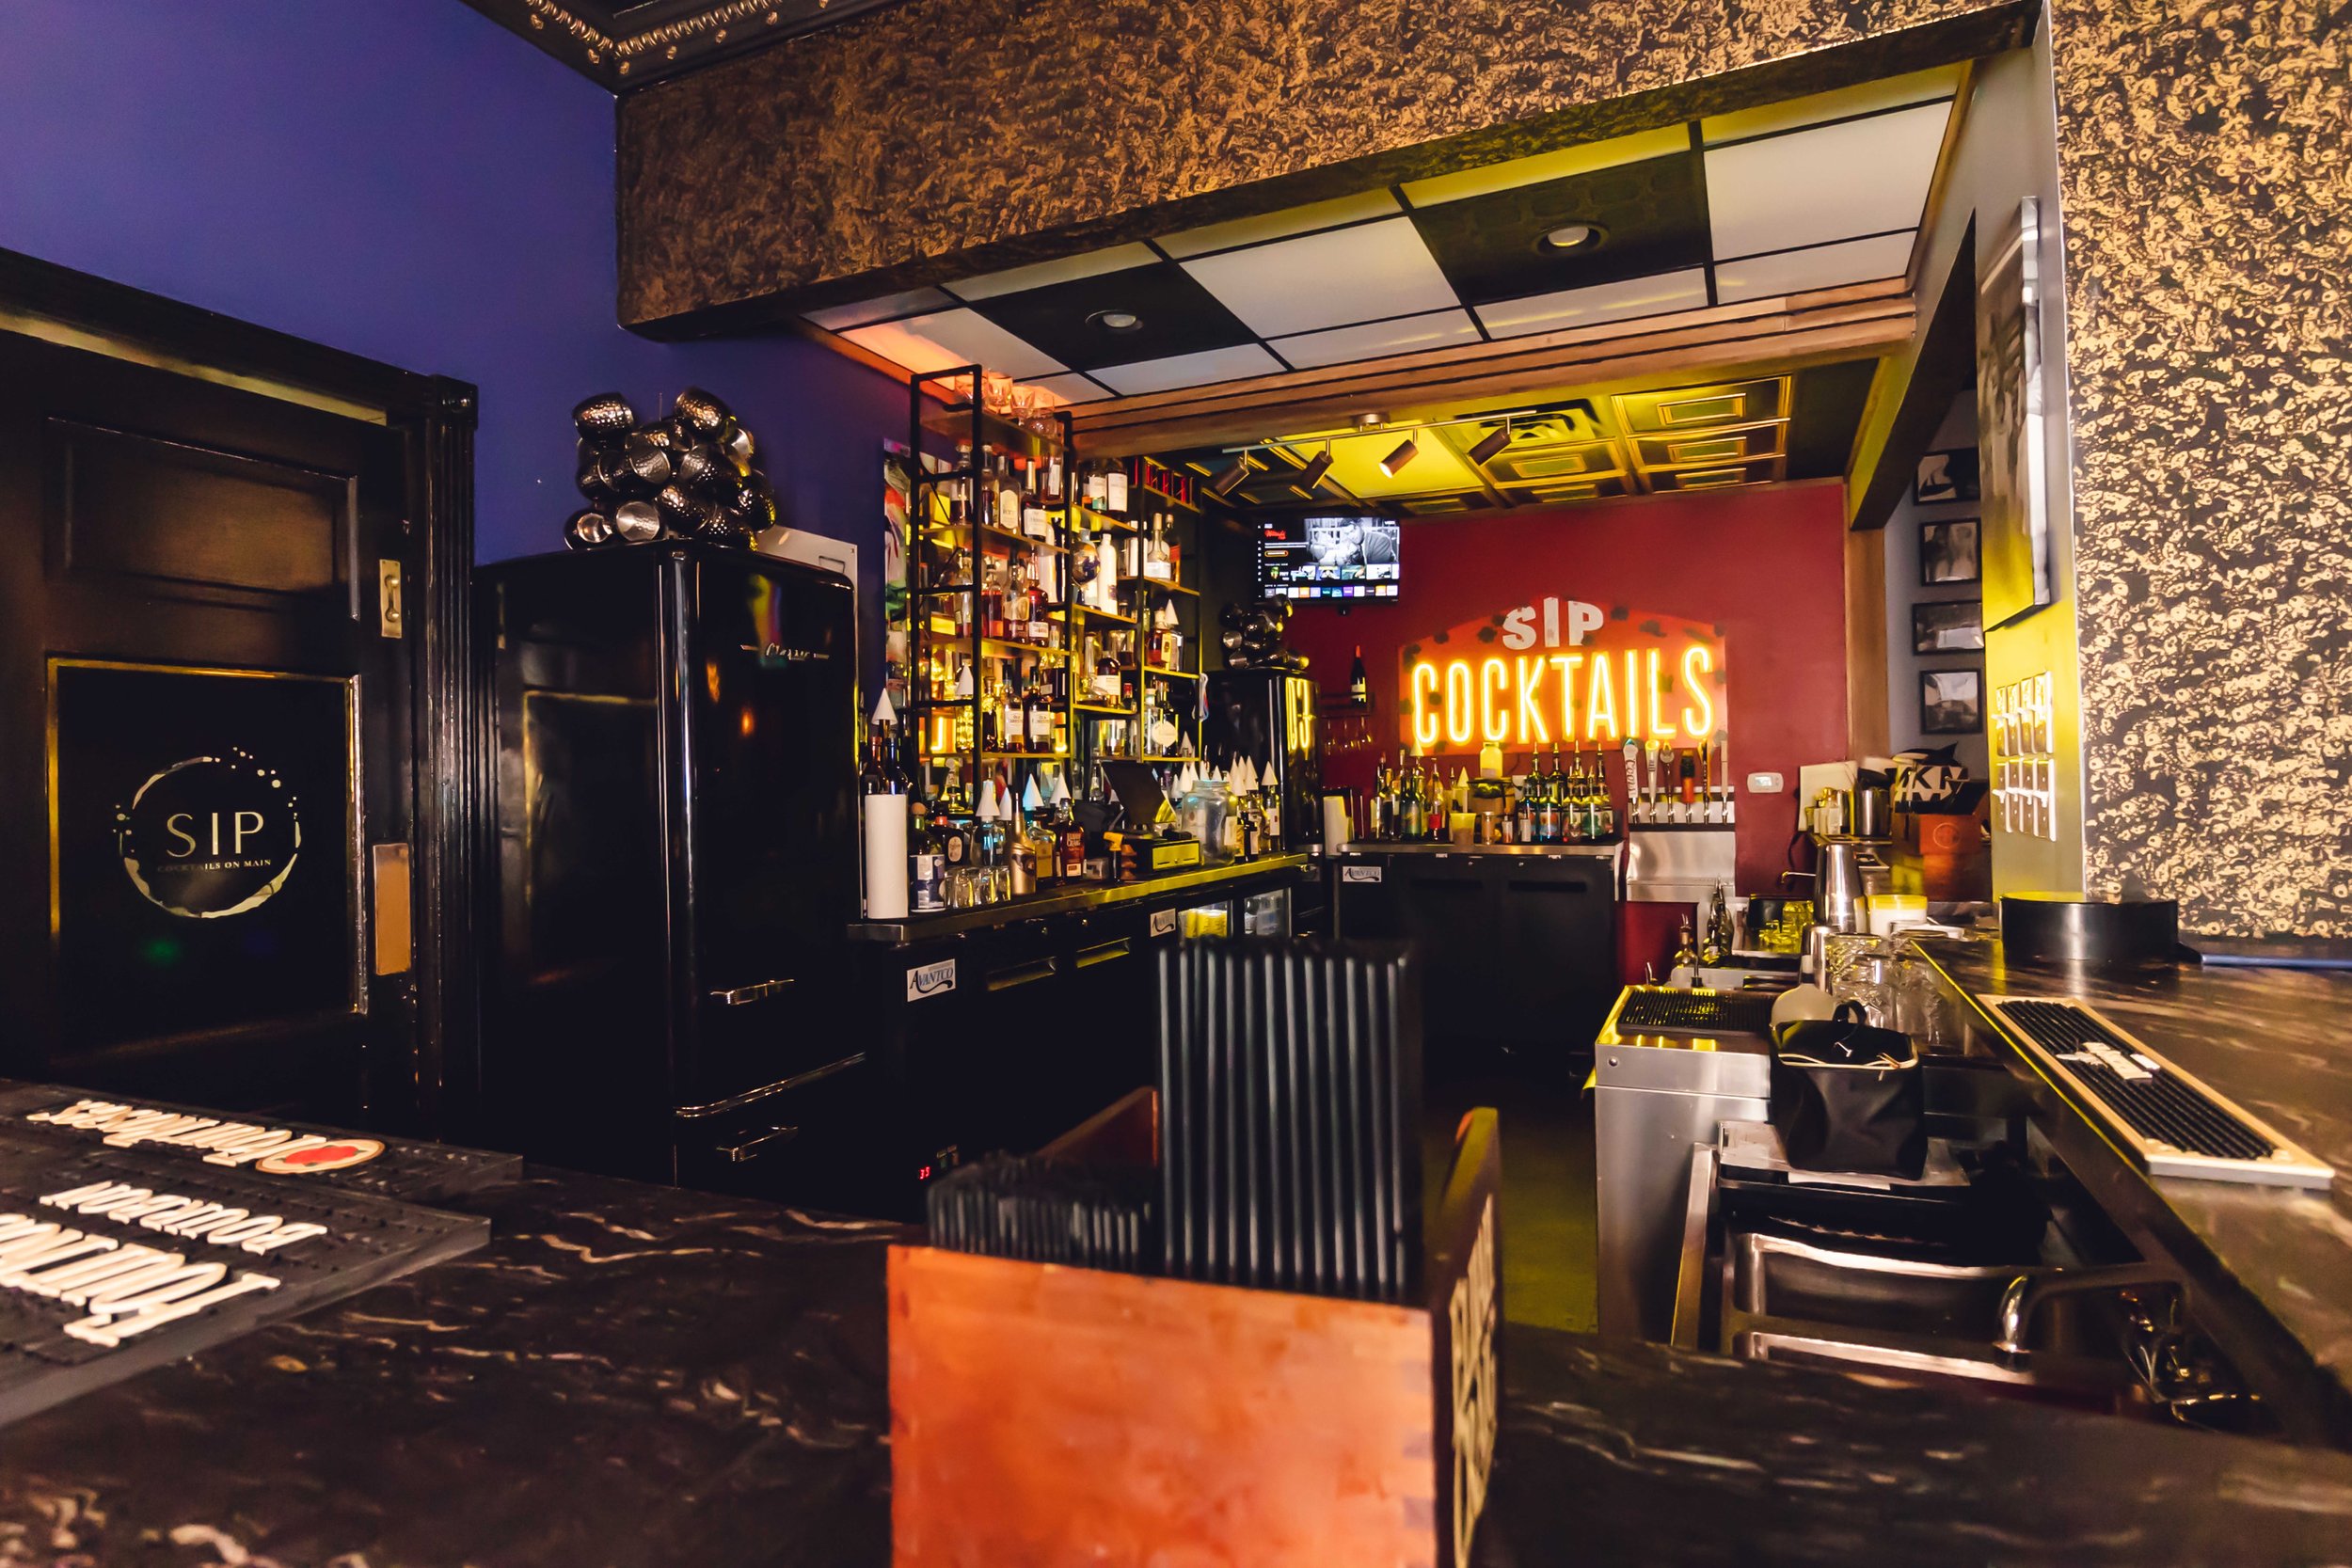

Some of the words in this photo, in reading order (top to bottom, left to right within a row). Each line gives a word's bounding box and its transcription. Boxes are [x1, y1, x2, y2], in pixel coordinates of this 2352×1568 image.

[1502, 596, 1604, 651] SIP
[1412, 643, 1713, 745] COCKTAILS
[167, 811, 264, 858] SIP
[225, 861, 240, 869] ON
[244, 859, 272, 867] MAIN
[40, 1180, 327, 1256] BOURBON
